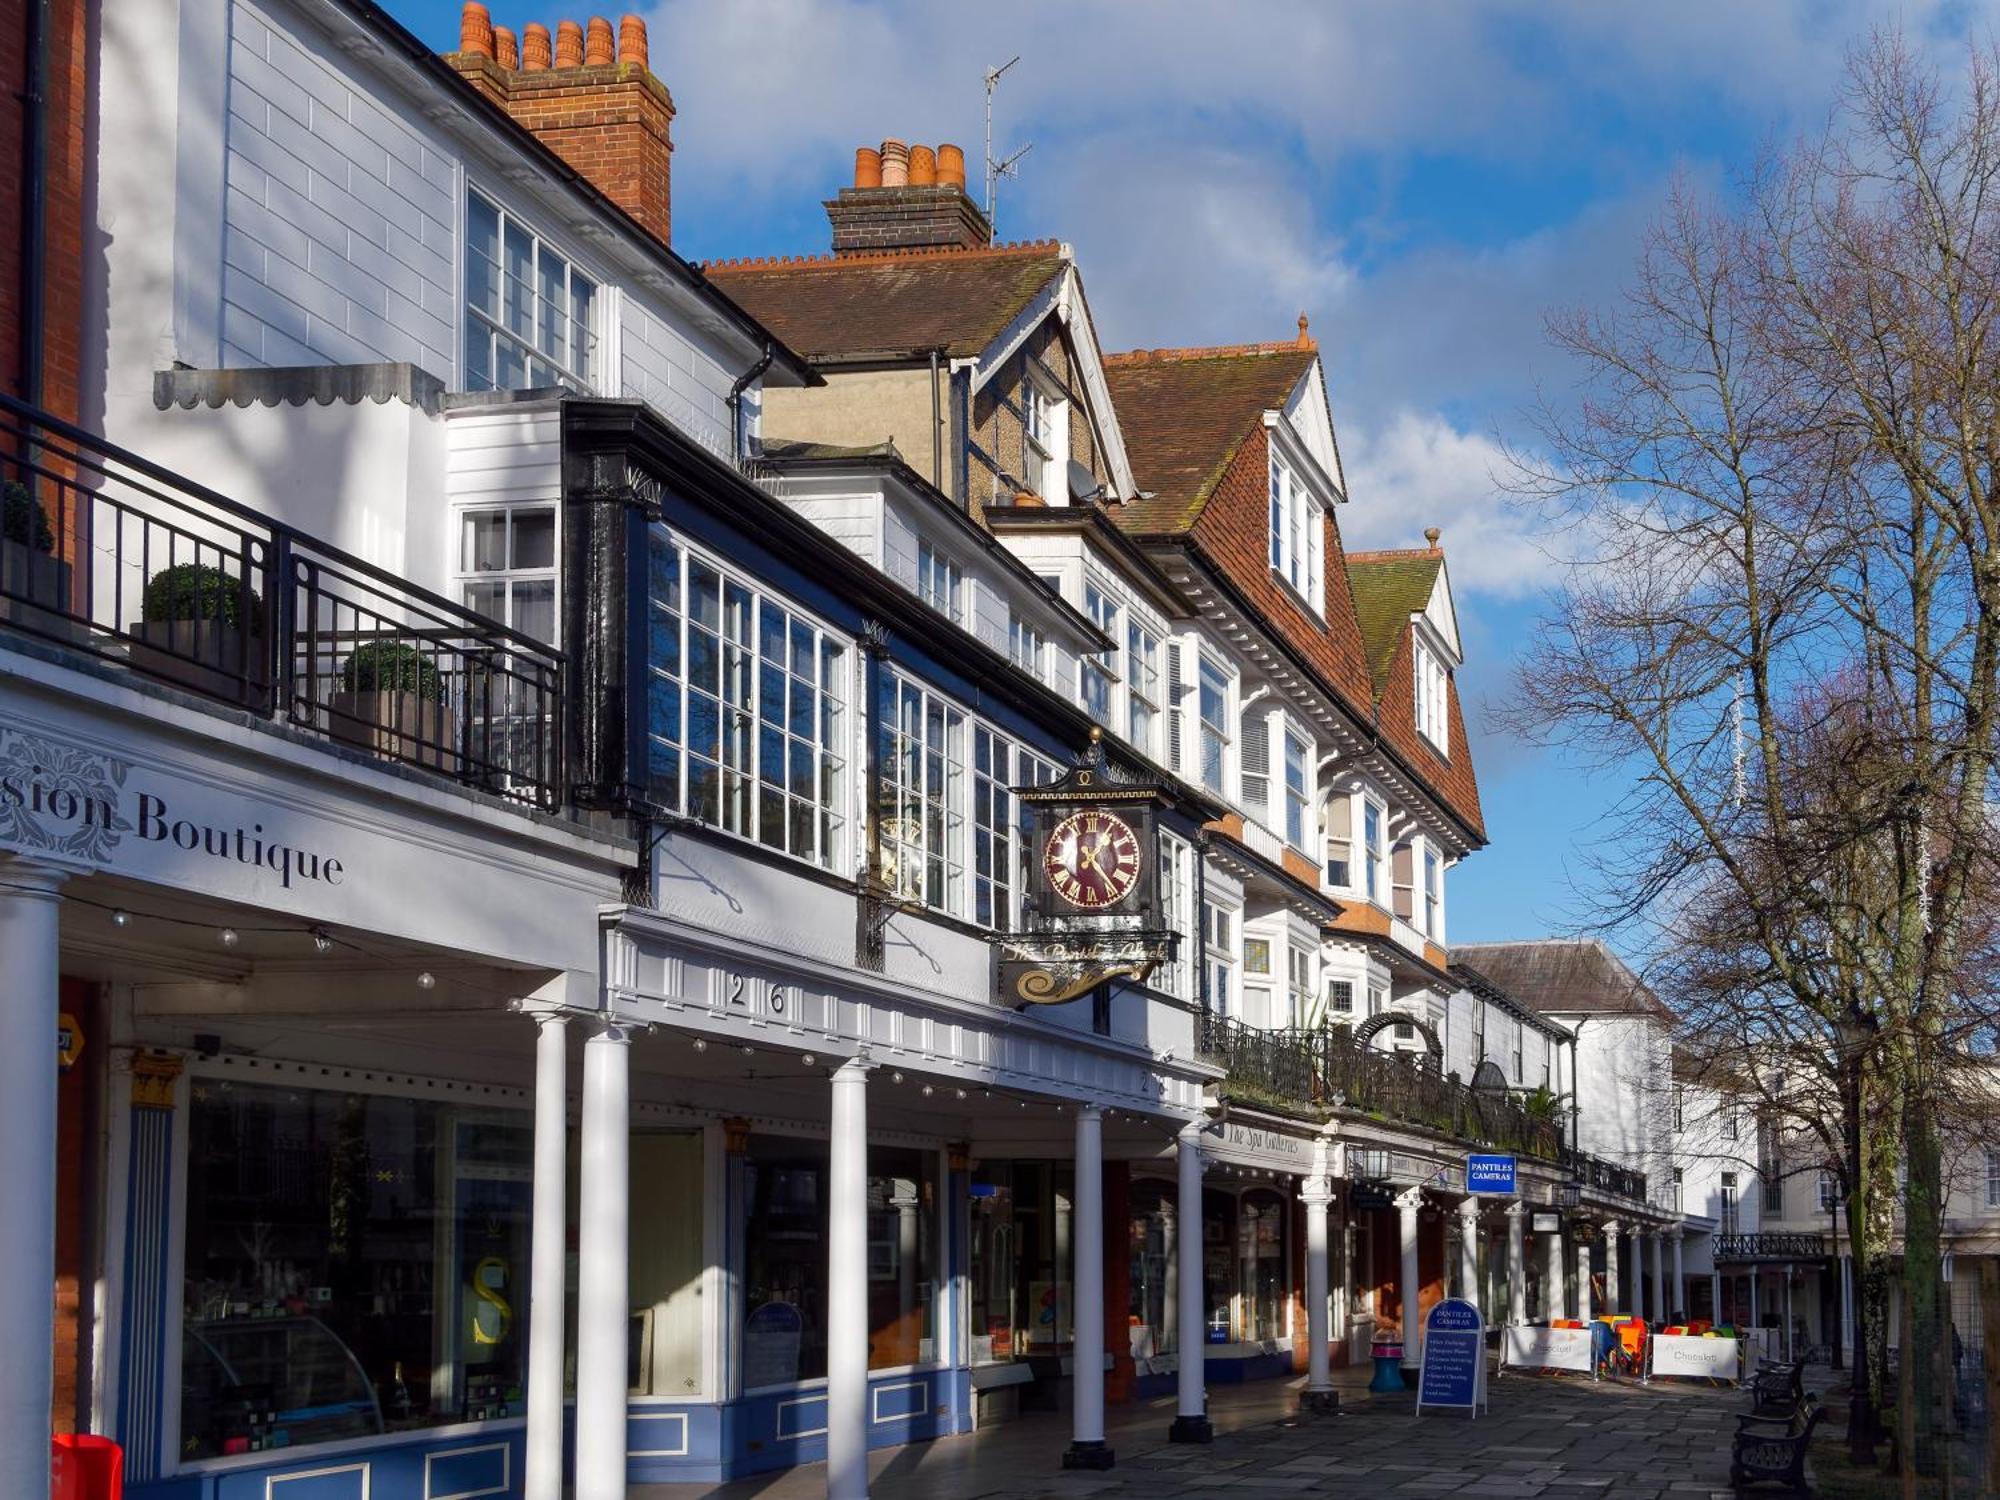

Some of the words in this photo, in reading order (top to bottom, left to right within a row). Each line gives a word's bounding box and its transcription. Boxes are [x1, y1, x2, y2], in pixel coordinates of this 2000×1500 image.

[134, 791, 345, 890] Boutique
[731, 973, 784, 1013] 26
[1471, 1163, 1513, 1173] PANTILES
[1472, 1172, 1511, 1182] CAMERAS
[1436, 1310, 1473, 1319] PANTILES
[1437, 1318, 1471, 1327] CAMERAS
